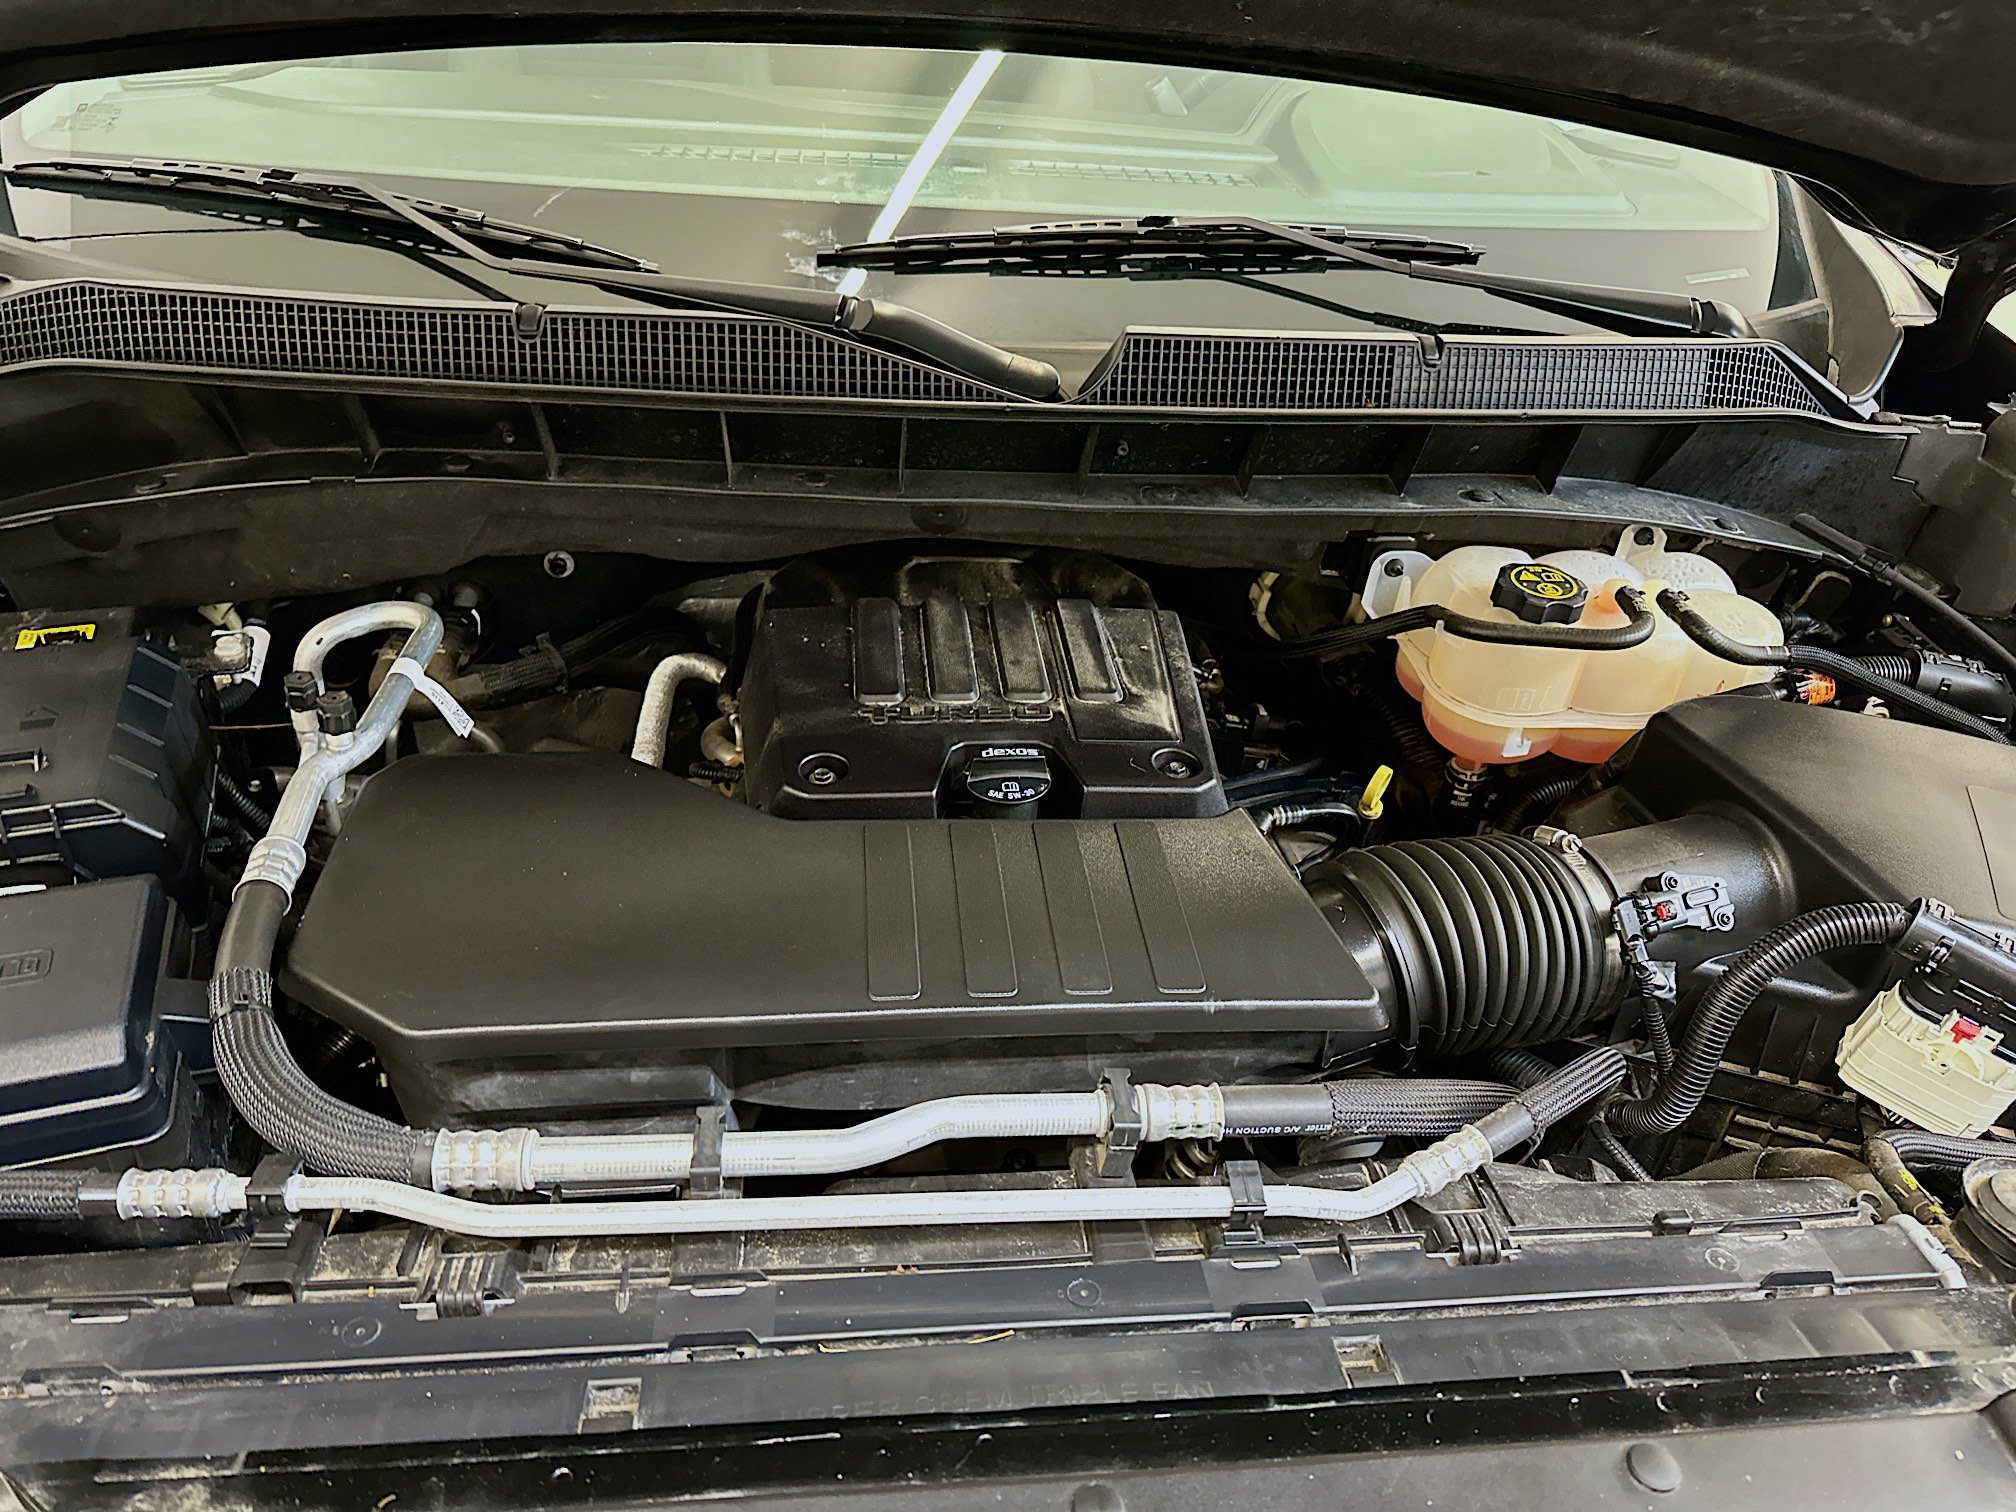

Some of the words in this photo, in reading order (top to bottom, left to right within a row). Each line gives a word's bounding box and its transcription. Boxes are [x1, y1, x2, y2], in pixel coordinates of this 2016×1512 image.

[981, 747, 1039, 757] dexos
[988, 789, 1005, 799] SAE
[1007, 788, 1036, 799] 5W-30
[1235, 1126, 1281, 1135] SUCTION
[1283, 1125, 1301, 1134] A/C
[1305, 1123, 1333, 1133] arrier
[1152, 1380, 1214, 1401] FAN
